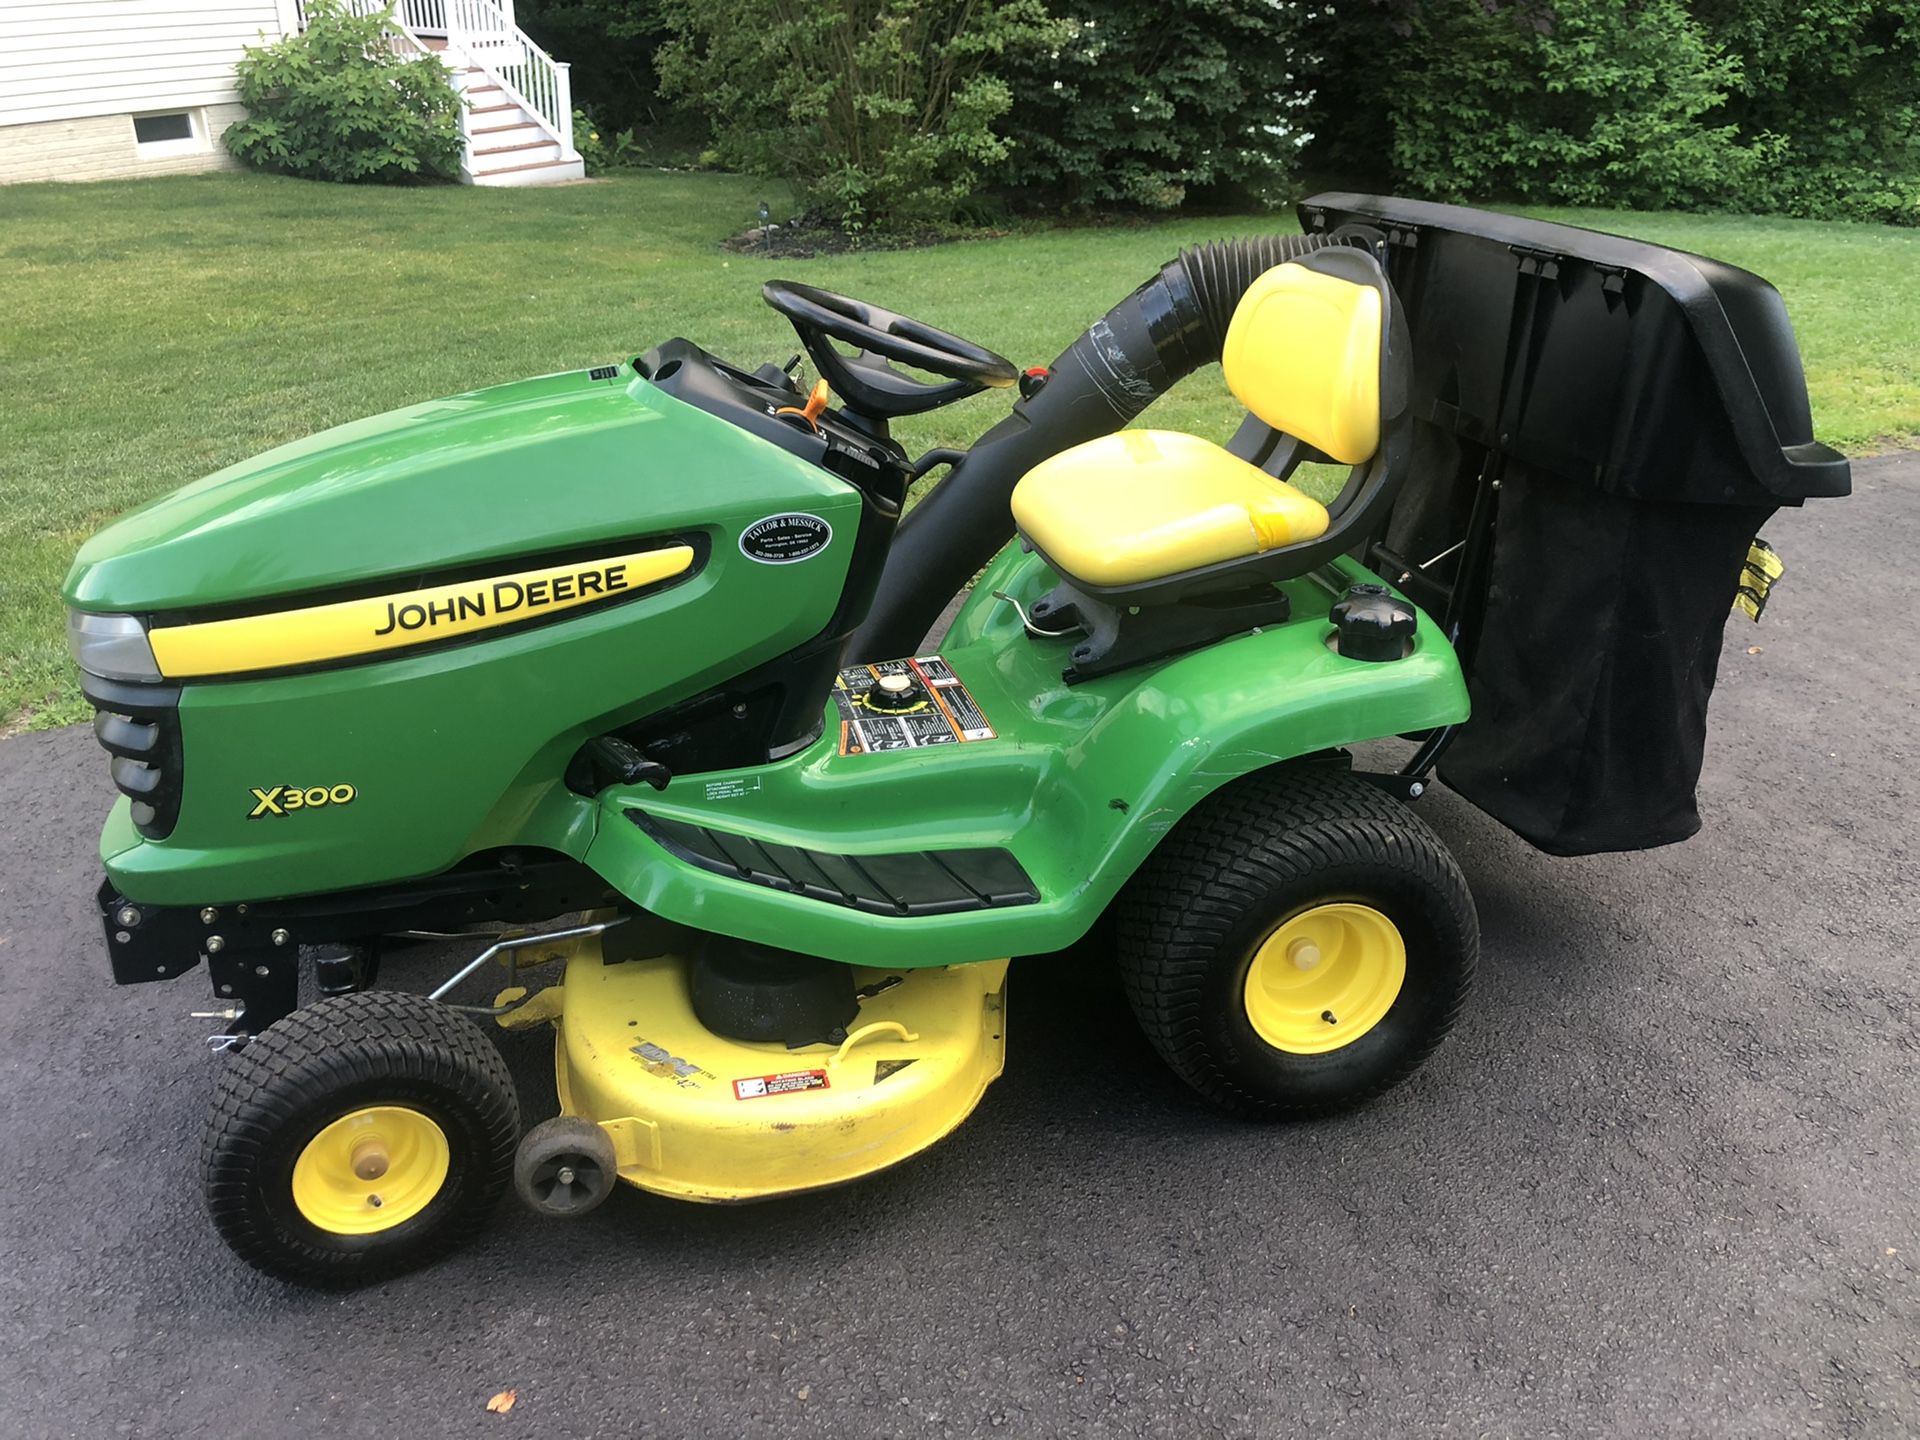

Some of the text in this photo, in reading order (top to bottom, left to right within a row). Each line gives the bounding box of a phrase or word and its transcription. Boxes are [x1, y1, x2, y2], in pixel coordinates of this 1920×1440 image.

[748, 518, 822, 540] TAYLOR & MESSICK
[375, 565, 629, 636] JOHN DEERE
[247, 783, 357, 820] X300
